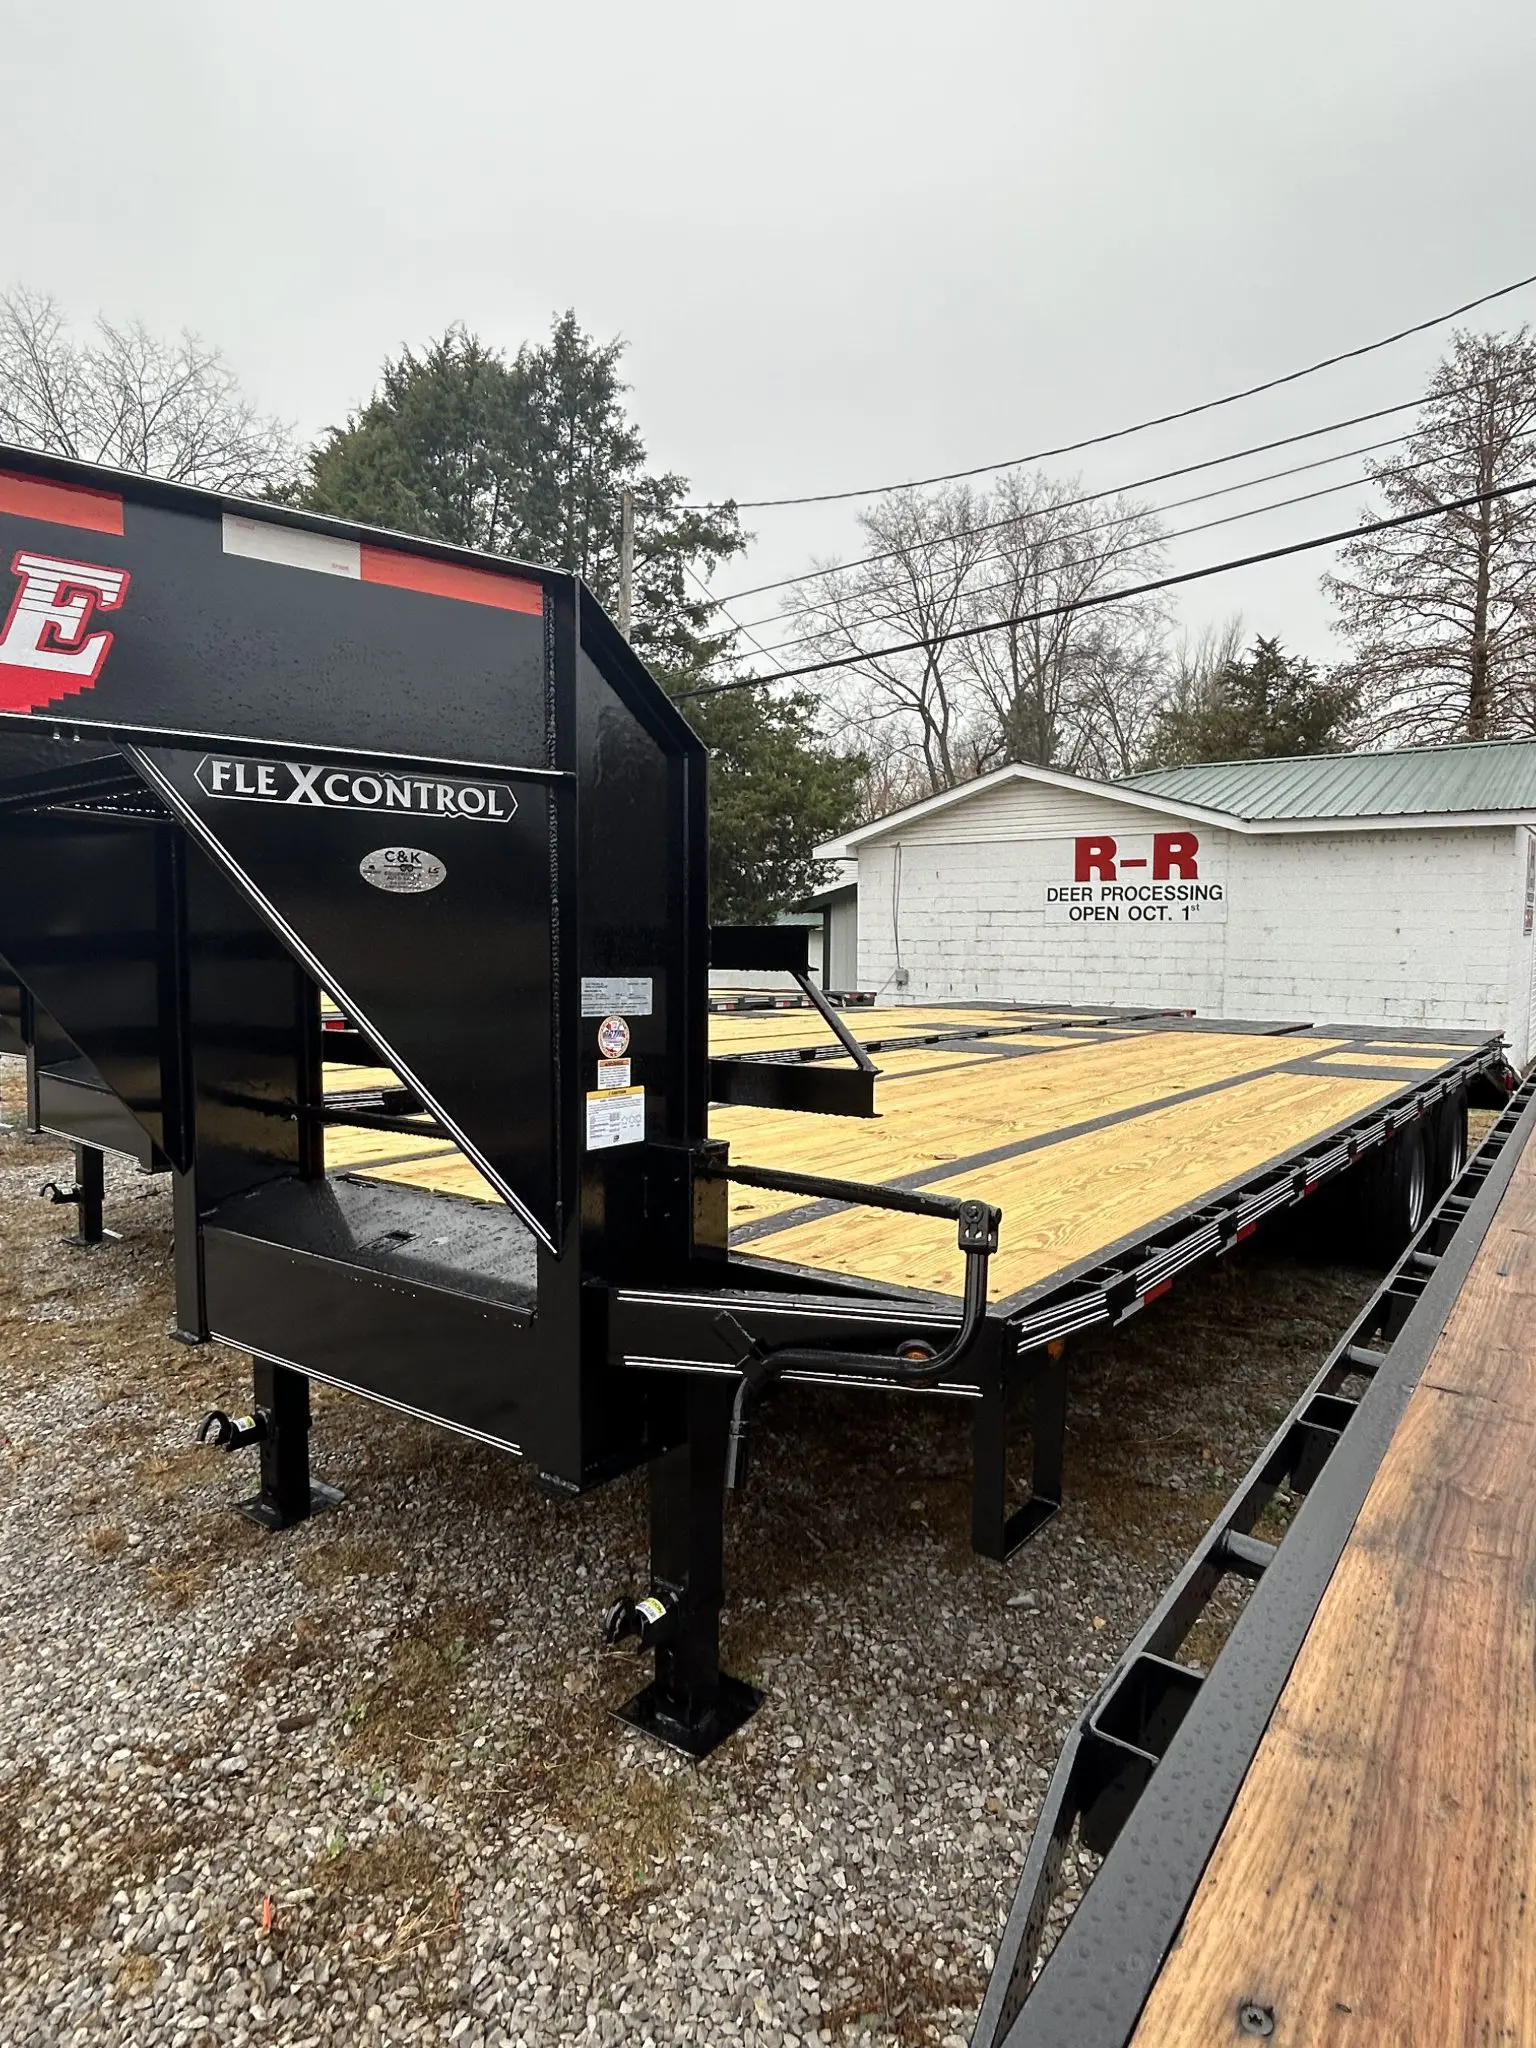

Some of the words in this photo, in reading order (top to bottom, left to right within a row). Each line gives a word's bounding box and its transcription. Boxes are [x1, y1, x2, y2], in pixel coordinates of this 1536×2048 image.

[211, 761, 504, 817] FLEXCONTROL
[384, 850, 421, 864] C&K
[1074, 831, 1199, 882] R-R
[1047, 887, 1093, 902] DEER
[1101, 885, 1223, 902] PROCESSING
[1069, 906, 1119, 921] OPEN
[1128, 905, 1172, 921] OCT.
[1181, 904, 1200, 921] 1st
